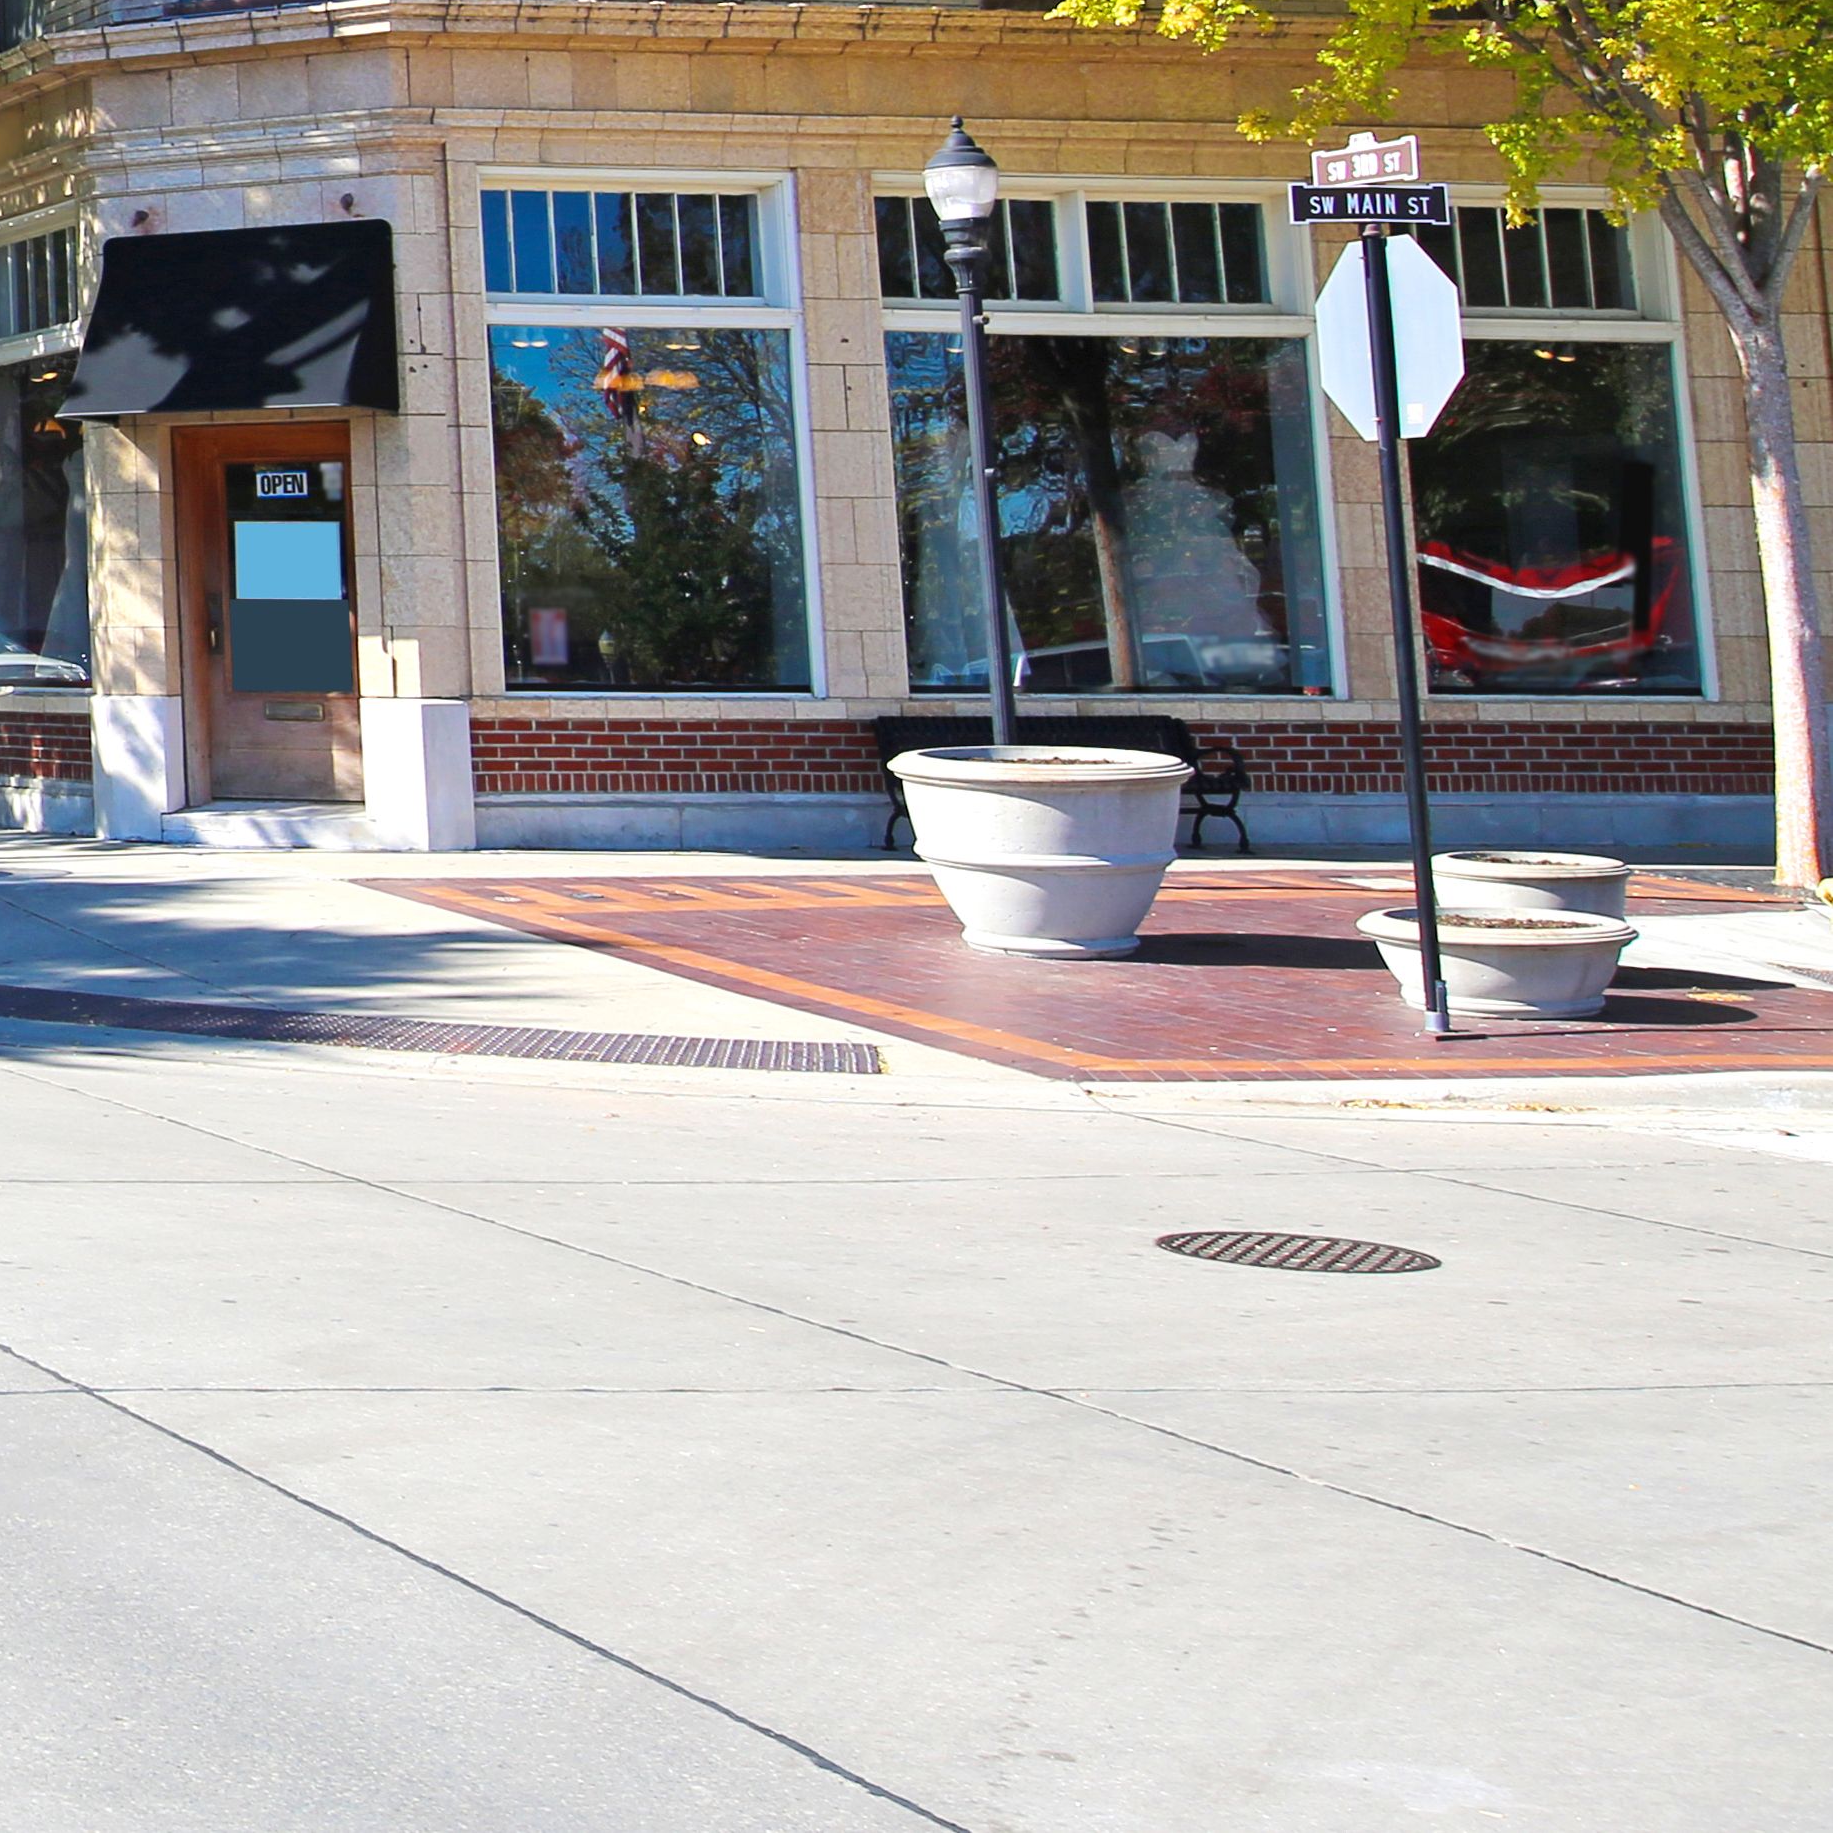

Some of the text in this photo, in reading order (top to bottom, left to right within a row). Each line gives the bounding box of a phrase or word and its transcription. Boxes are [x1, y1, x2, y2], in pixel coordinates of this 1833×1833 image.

[1383, 150, 1402, 173] ST
[1309, 192, 1430, 215] SW MAIN ST
[260, 474, 305, 495] OPEN
